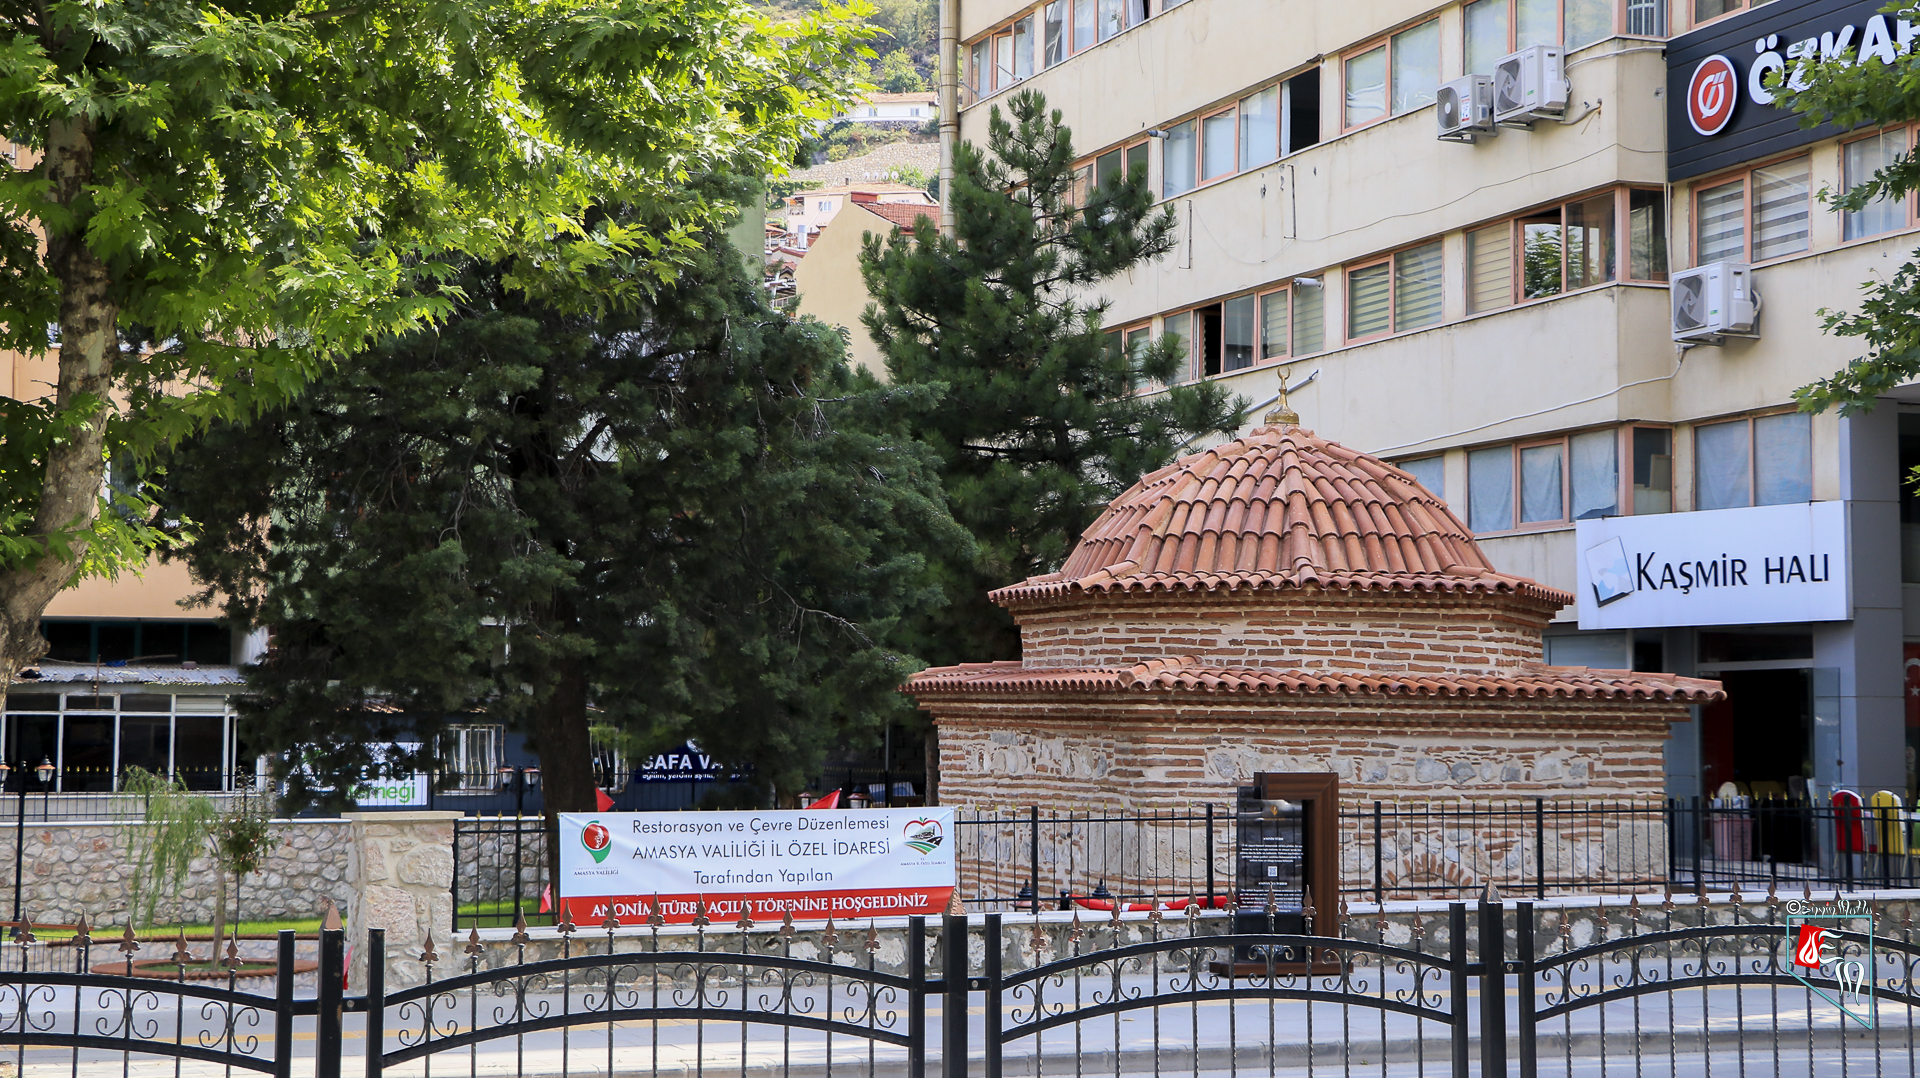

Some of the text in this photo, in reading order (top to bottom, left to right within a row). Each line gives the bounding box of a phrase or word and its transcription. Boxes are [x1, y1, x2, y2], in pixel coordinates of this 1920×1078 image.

[1636, 552, 1829, 594] KAŞMİR HALI
[641, 753, 693, 770] SAFA
[632, 815, 890, 836] Restorasyon ve Çevre Düzenlemesi
[632, 837, 890, 859] AMASYA VALİLİĞİ İL ÖZEL İDARESİ
[693, 868, 833, 885] Tarafından Yapılan
[659, 899, 706, 915] TÜRB
[756, 895, 828, 913] TÖRENİNE
[831, 893, 929, 913] HOŞGELDİNİZ
